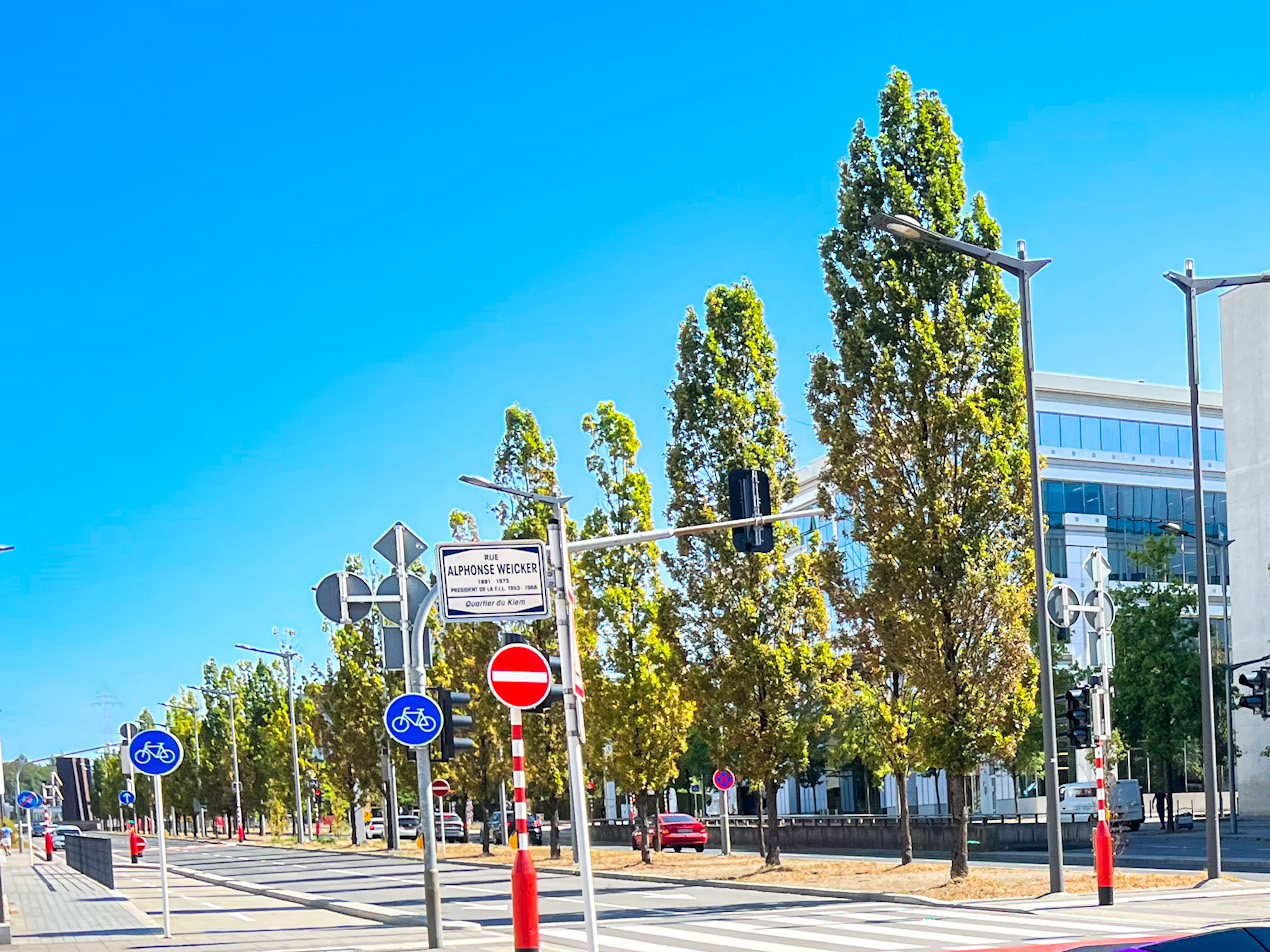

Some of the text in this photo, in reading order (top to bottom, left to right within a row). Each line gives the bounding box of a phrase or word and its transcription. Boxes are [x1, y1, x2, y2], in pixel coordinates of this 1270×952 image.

[447, 563, 538, 577] ALPHONSE WEICKER
[465, 600, 495, 608] Quartier
